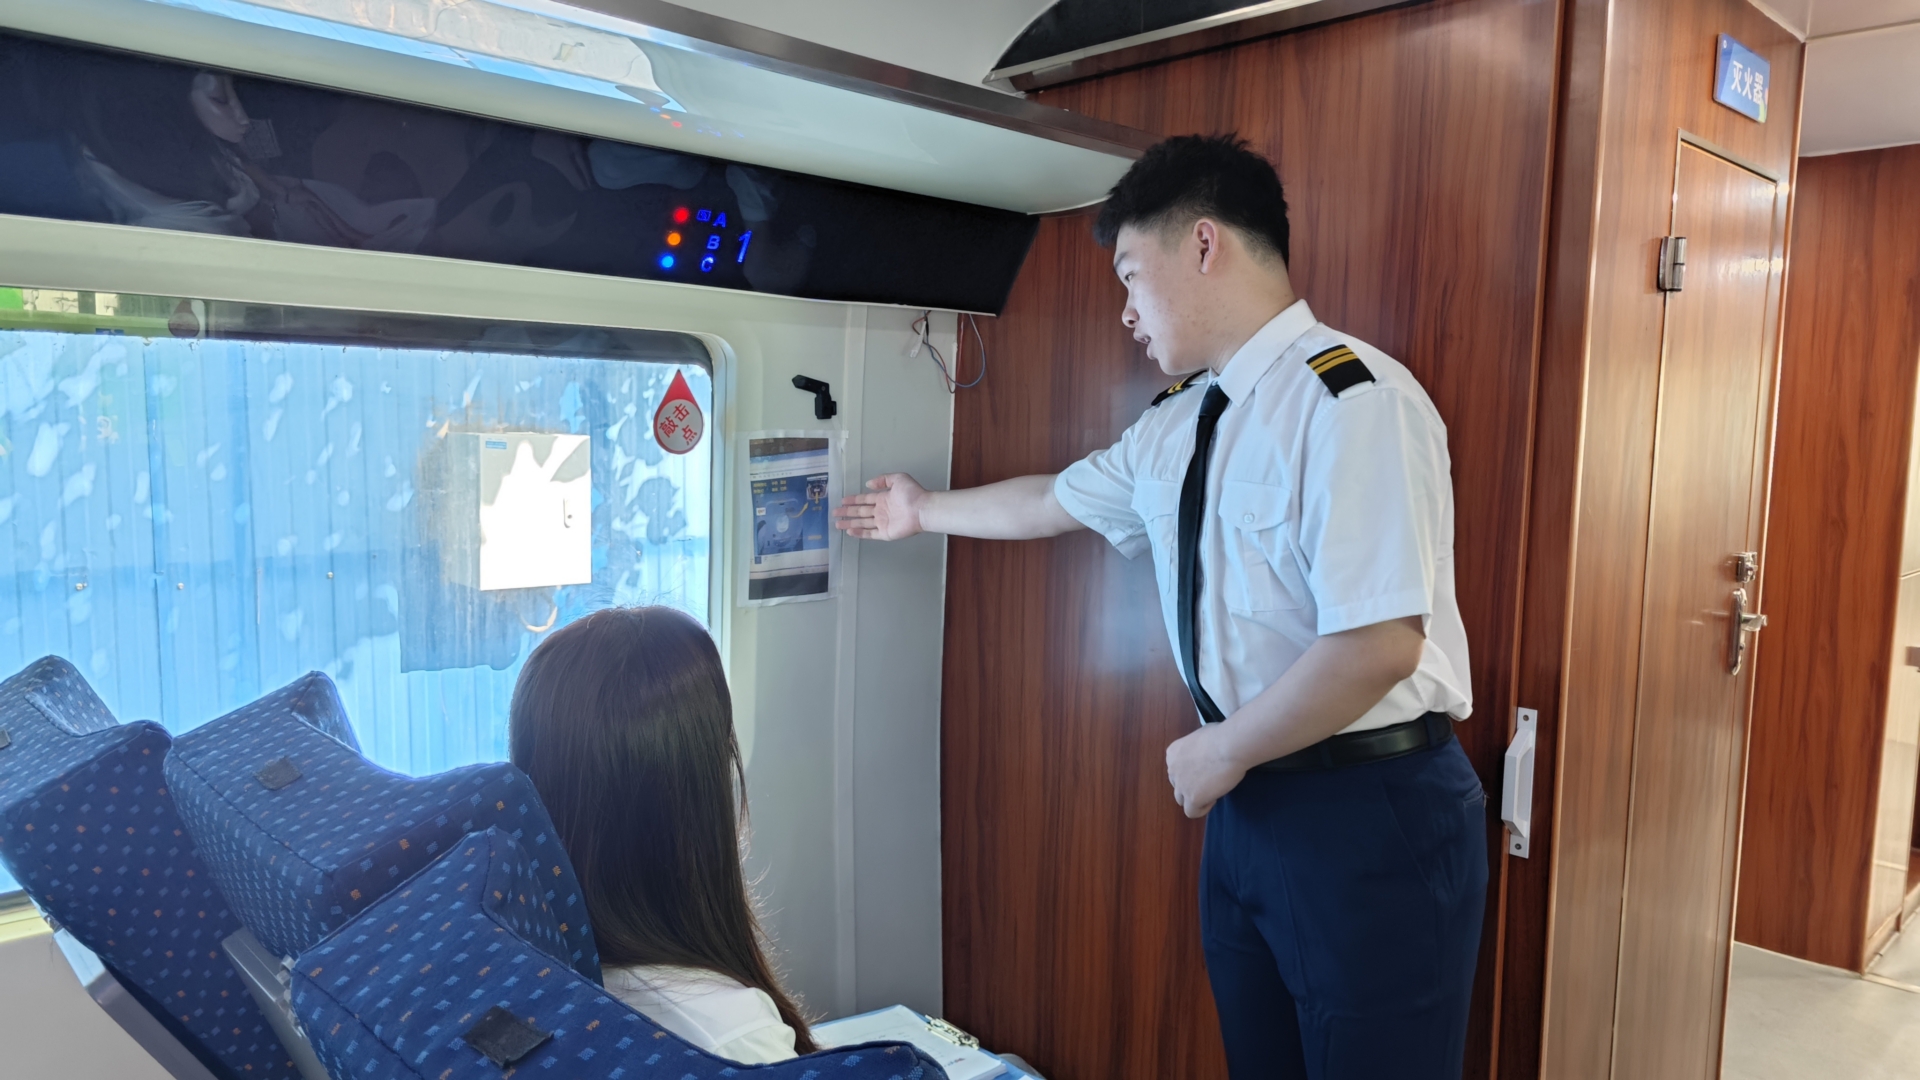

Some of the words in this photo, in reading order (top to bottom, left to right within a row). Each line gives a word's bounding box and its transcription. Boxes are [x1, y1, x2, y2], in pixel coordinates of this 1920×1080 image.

[1731, 60, 1764, 105] 灭火器
[713, 212, 727, 227] A
[707, 235, 720, 250] B
[738, 230, 752, 262] 1
[701, 255, 714, 272] C
